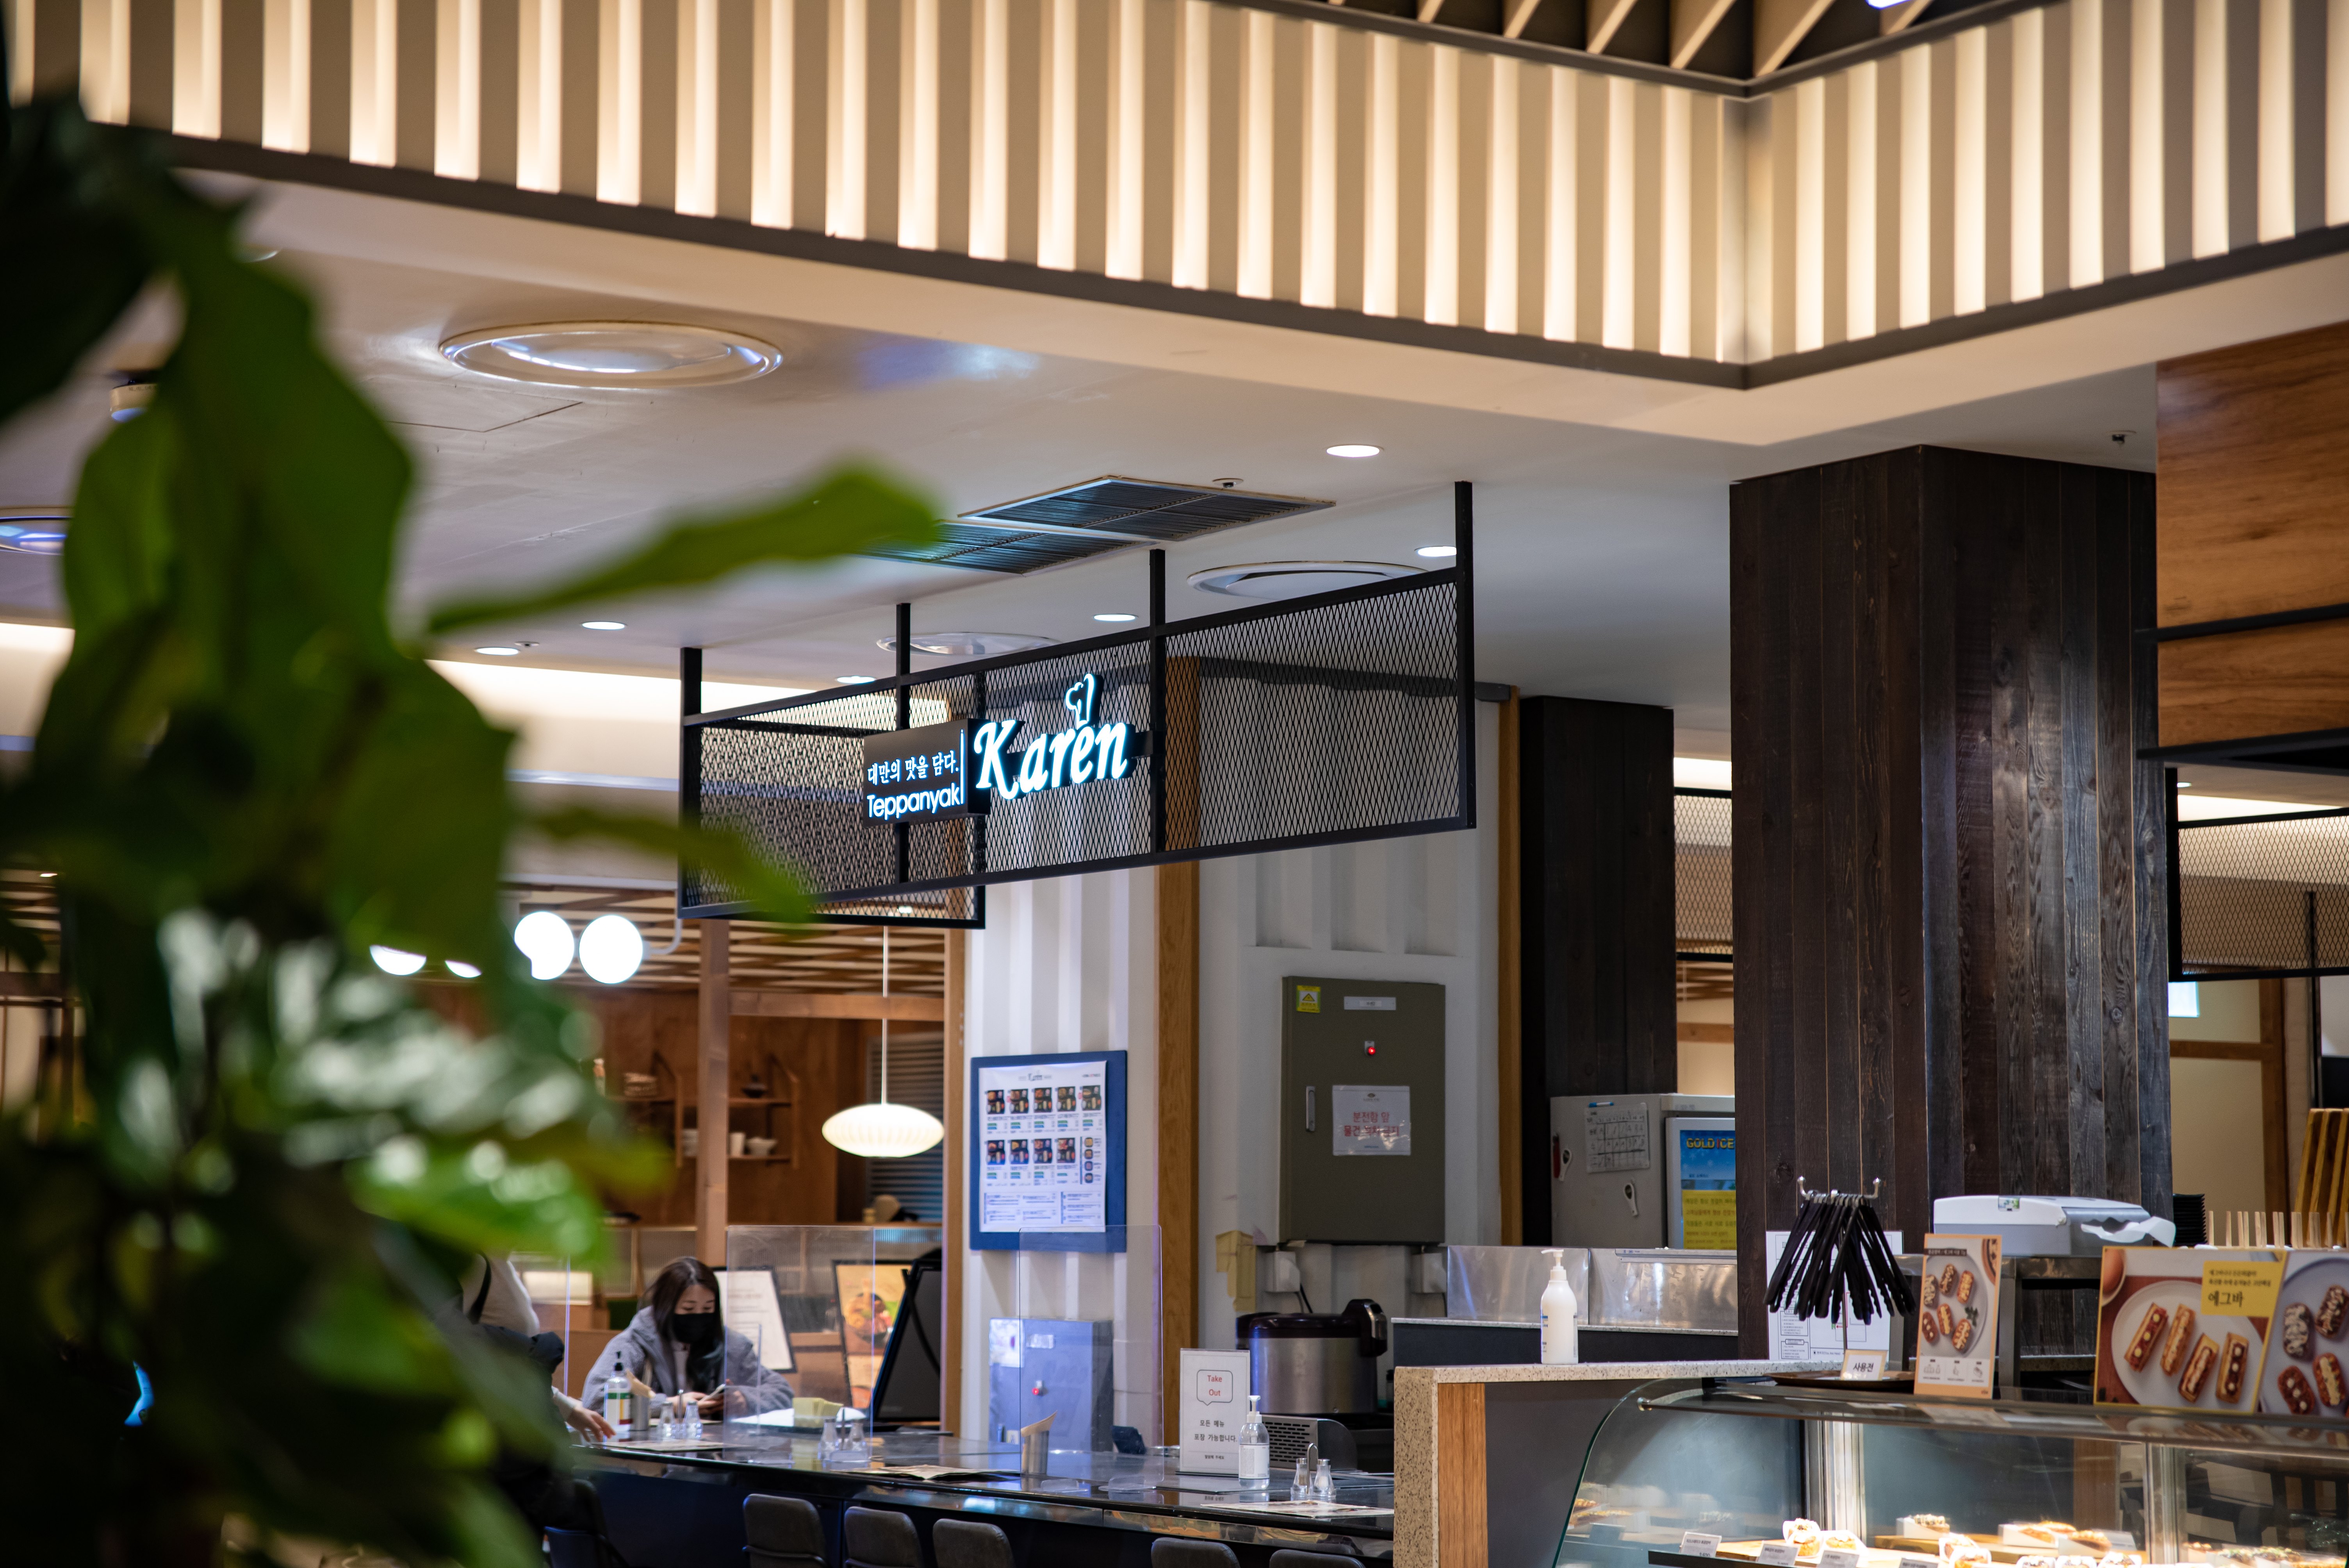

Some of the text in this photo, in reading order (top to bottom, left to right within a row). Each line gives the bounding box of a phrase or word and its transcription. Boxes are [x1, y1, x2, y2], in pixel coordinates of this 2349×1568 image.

[974, 720, 1127, 800] Karen
[868, 750, 959, 786] 대만의 맛을 담다.
[1686, 1138, 1715, 1149] GOLD
[2208, 1290, 2243, 1307] 에그바
[1853, 1362, 1874, 1372] 사용전
[1207, 1374, 1223, 1383] Take
[1208, 1434, 1237, 1443] 가능합니다.
